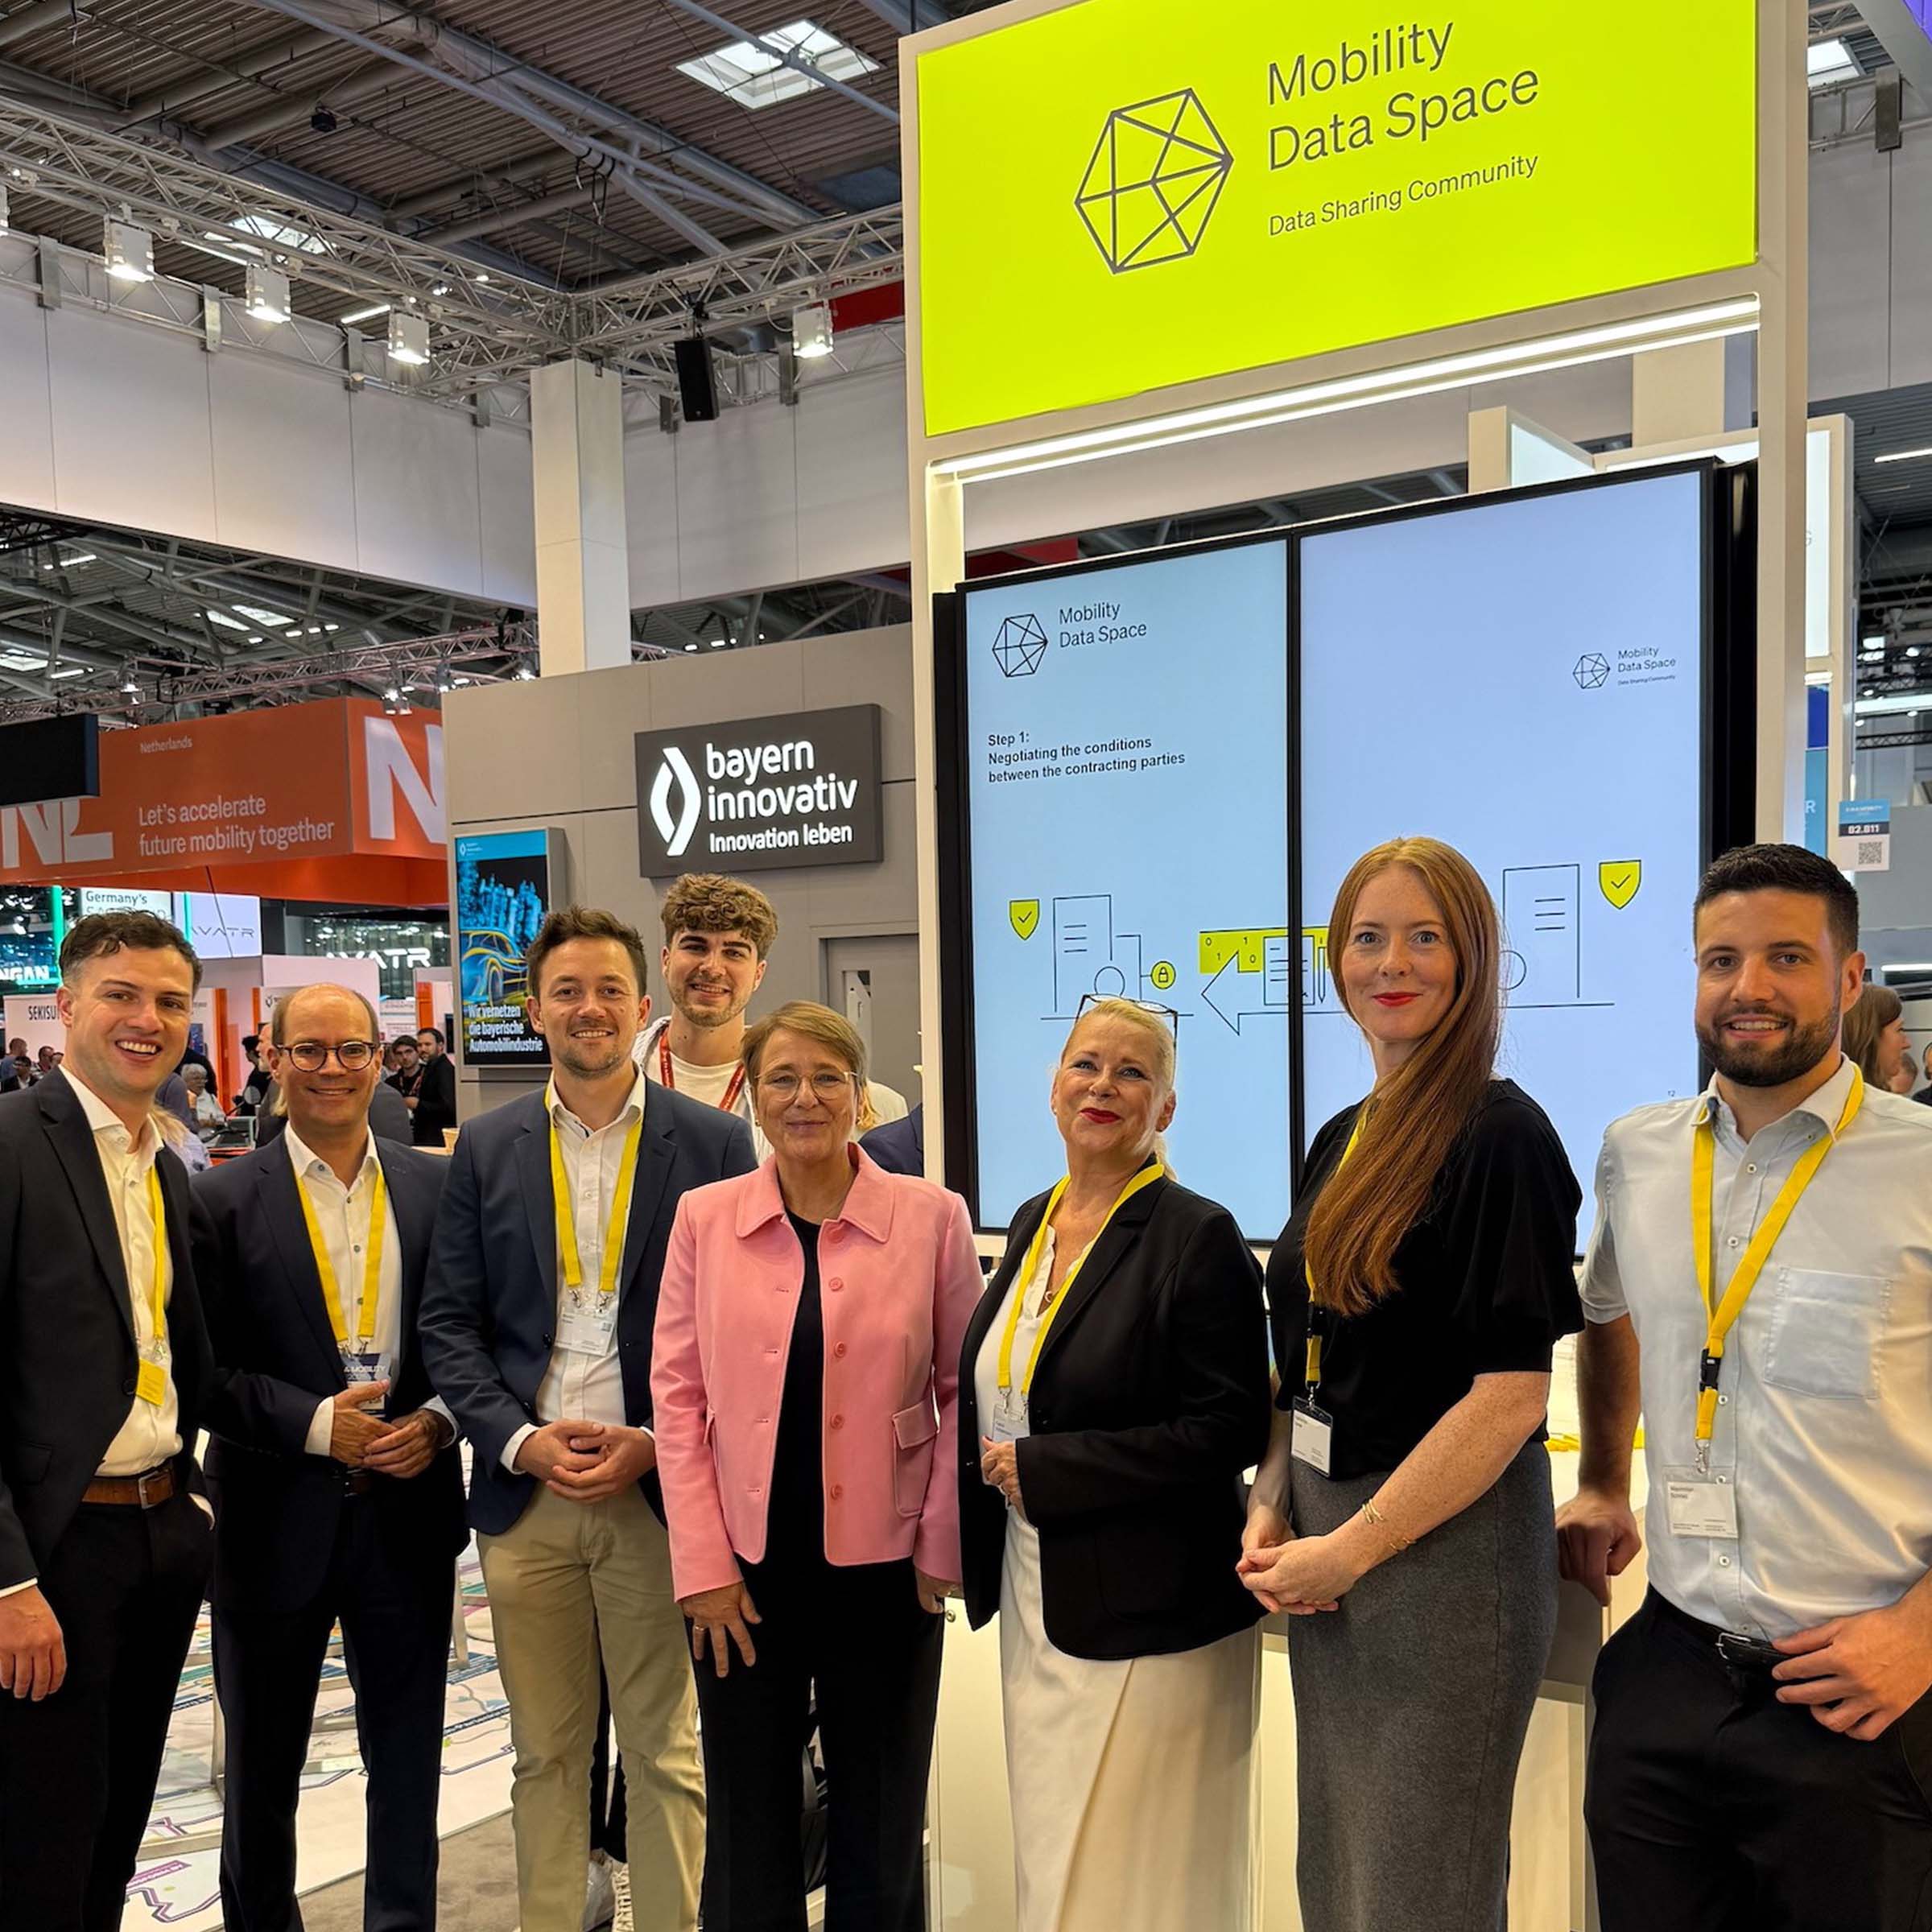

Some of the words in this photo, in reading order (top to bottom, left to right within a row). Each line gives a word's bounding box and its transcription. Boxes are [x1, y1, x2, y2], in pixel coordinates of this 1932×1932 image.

[1269, 22, 1453, 105] Mobility
[1269, 105, 1373, 171] Data
[1385, 68, 1539, 141] Space
[1269, 210, 1317, 237] Data
[1321, 186, 1402, 222] Sharing
[1406, 154, 1538, 202] Community
[1059, 601, 1121, 625] Mobility
[1059, 626, 1095, 647] Data
[1097, 621, 1146, 644] Space
[1618, 646, 1659, 659] Mobility
[1618, 662, 1641, 672] Data
[1643, 658, 1676, 670] Space
[139, 734, 192, 753] Netherlands
[988, 733, 1015, 749] Step
[1018, 730, 1030, 743] 1:
[988, 745, 1058, 765] Negotiating
[1060, 742, 1081, 758] the
[1084, 735, 1152, 755] conditions
[705, 740, 814, 786] bayern
[988, 766, 1039, 782] between
[1042, 762, 1061, 778] the
[1064, 755, 1137, 775] contracting
[1139, 750, 1185, 769] parties
[138, 802, 175, 826] Let's
[180, 794, 266, 822] accelerate
[707, 772, 858, 821] innovativ
[1, 797, 114, 868] NL
[138, 832, 186, 857] future
[189, 824, 255, 854] mobility
[258, 816, 335, 850] together
[708, 826, 799, 852] Innovation
[803, 821, 852, 845] leben
[85, 890, 147, 906] Germany's
[469, 1021, 481, 1034] die
[481, 1020, 524, 1038] bayerische
[469, 1036, 543, 1052] Automobilindustrie
